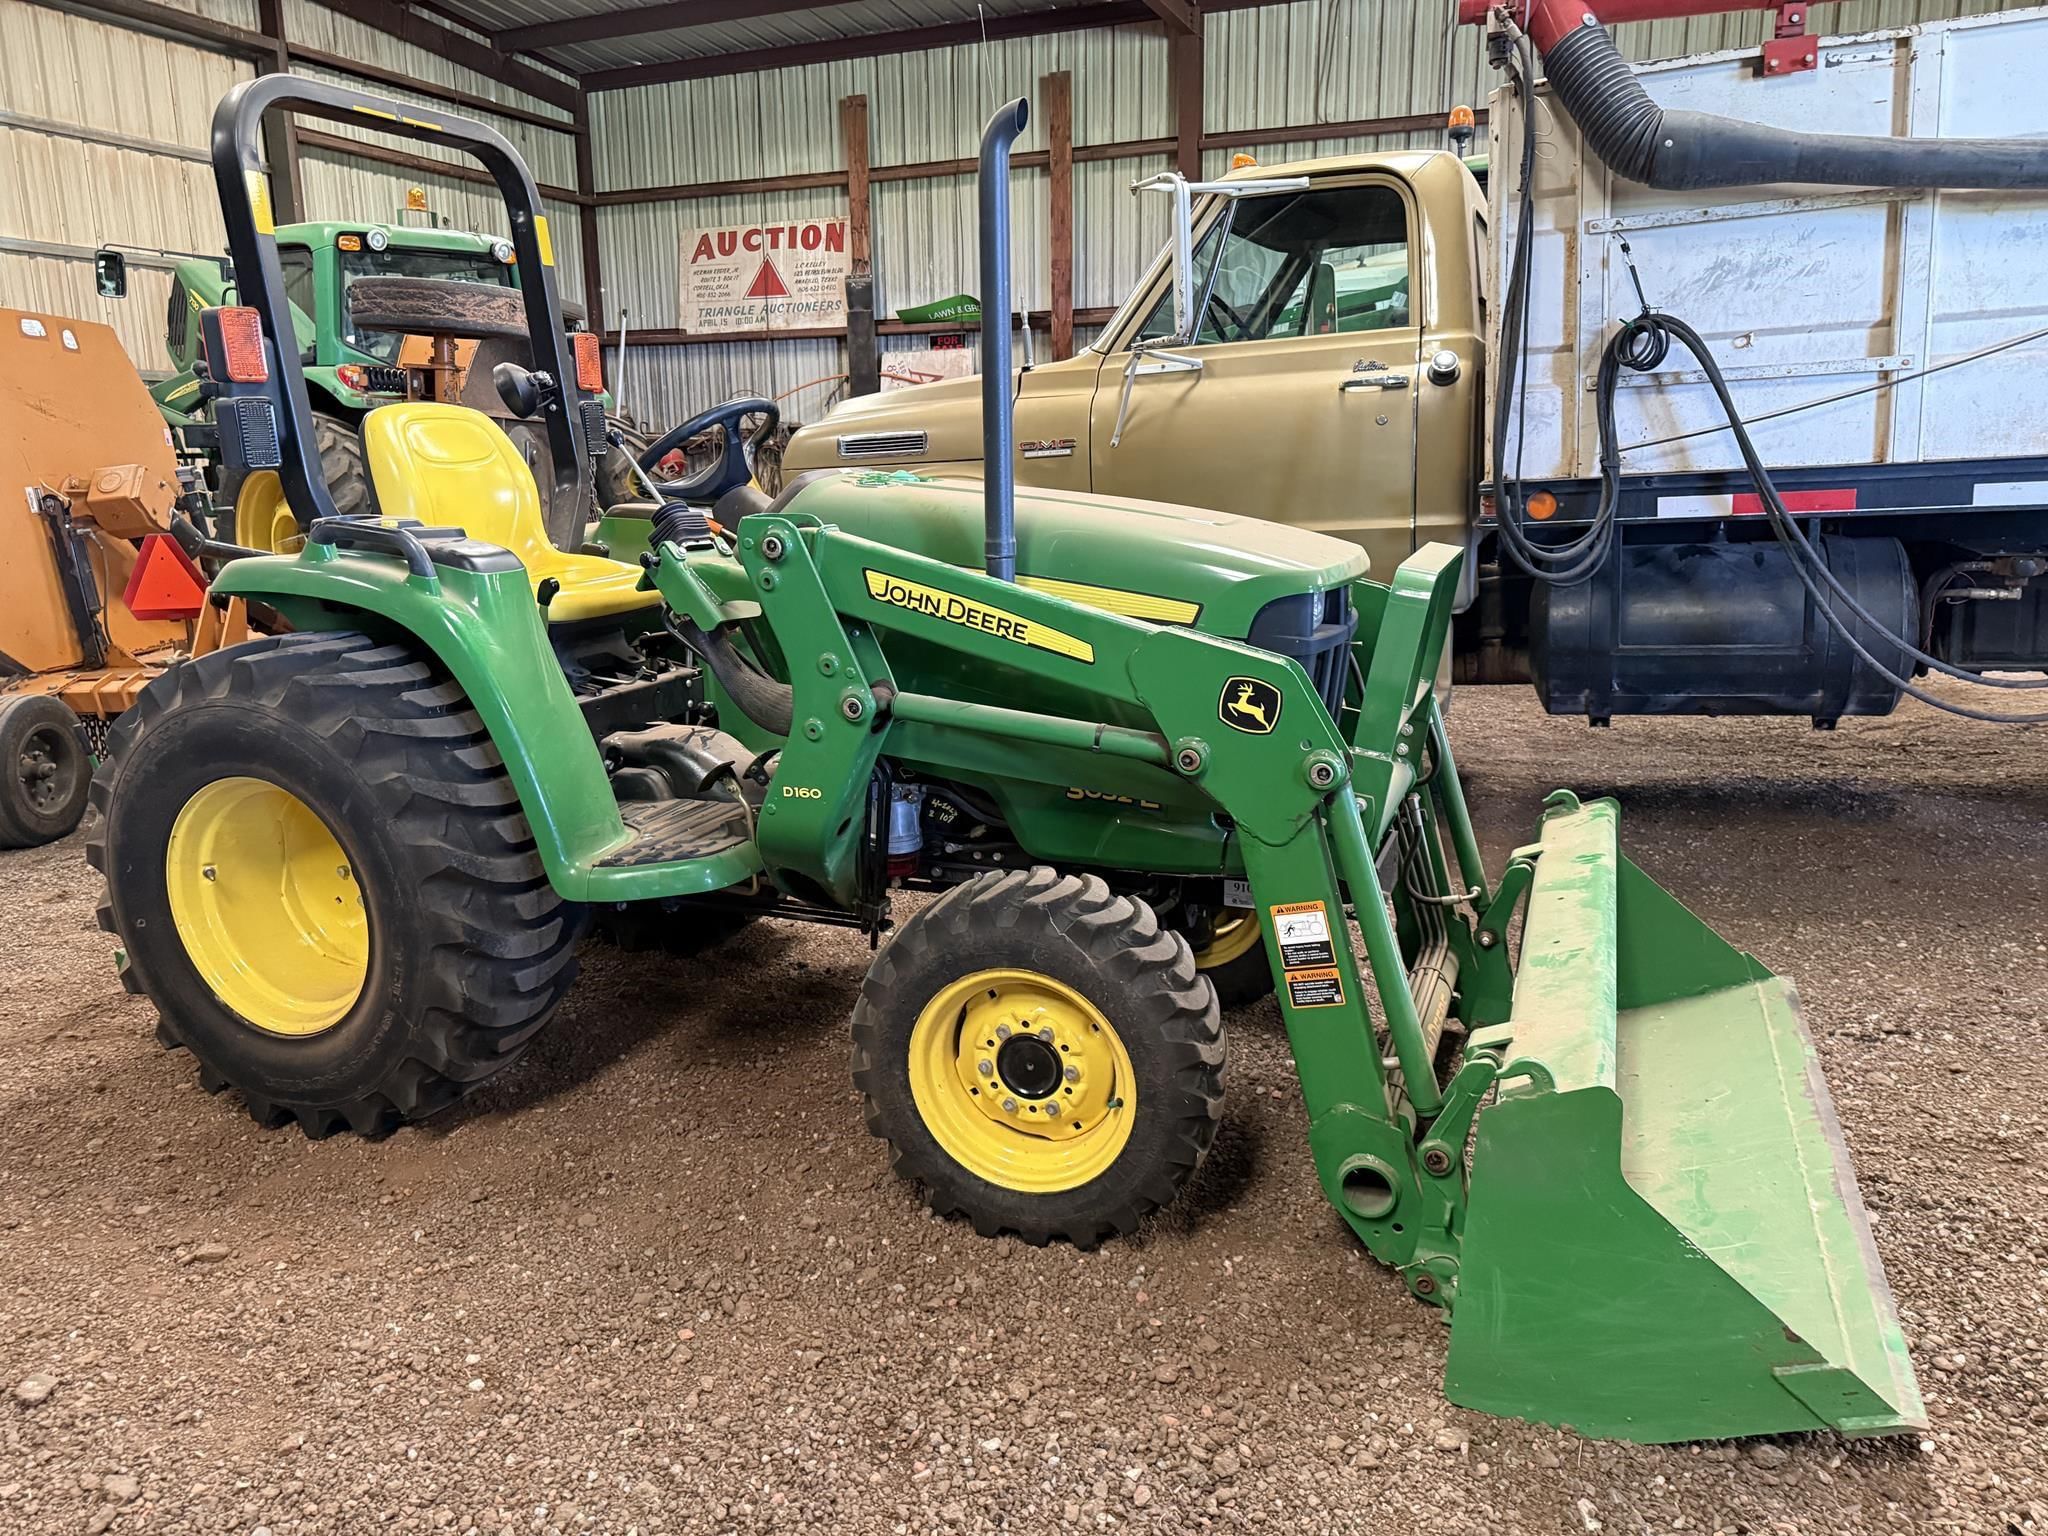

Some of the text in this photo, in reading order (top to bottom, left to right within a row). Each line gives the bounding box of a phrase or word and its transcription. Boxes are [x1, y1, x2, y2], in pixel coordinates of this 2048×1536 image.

[691, 222, 845, 264] AUCTION
[698, 300, 842, 318] TRIANGLE AUCTIONEERS
[928, 306, 955, 320] LAWN
[957, 305, 964, 314] &
[698, 318, 718, 328] APRIL
[720, 317, 728, 326] 15
[755, 316, 767, 324] AM
[937, 336, 958, 345] FOR
[1018, 437, 1077, 451] GMC
[875, 579, 1029, 641] JOHN DEERE
[782, 785, 823, 800] D160
[1284, 903, 1319, 913] WARNING
[1299, 971, 1334, 981] WARNING
